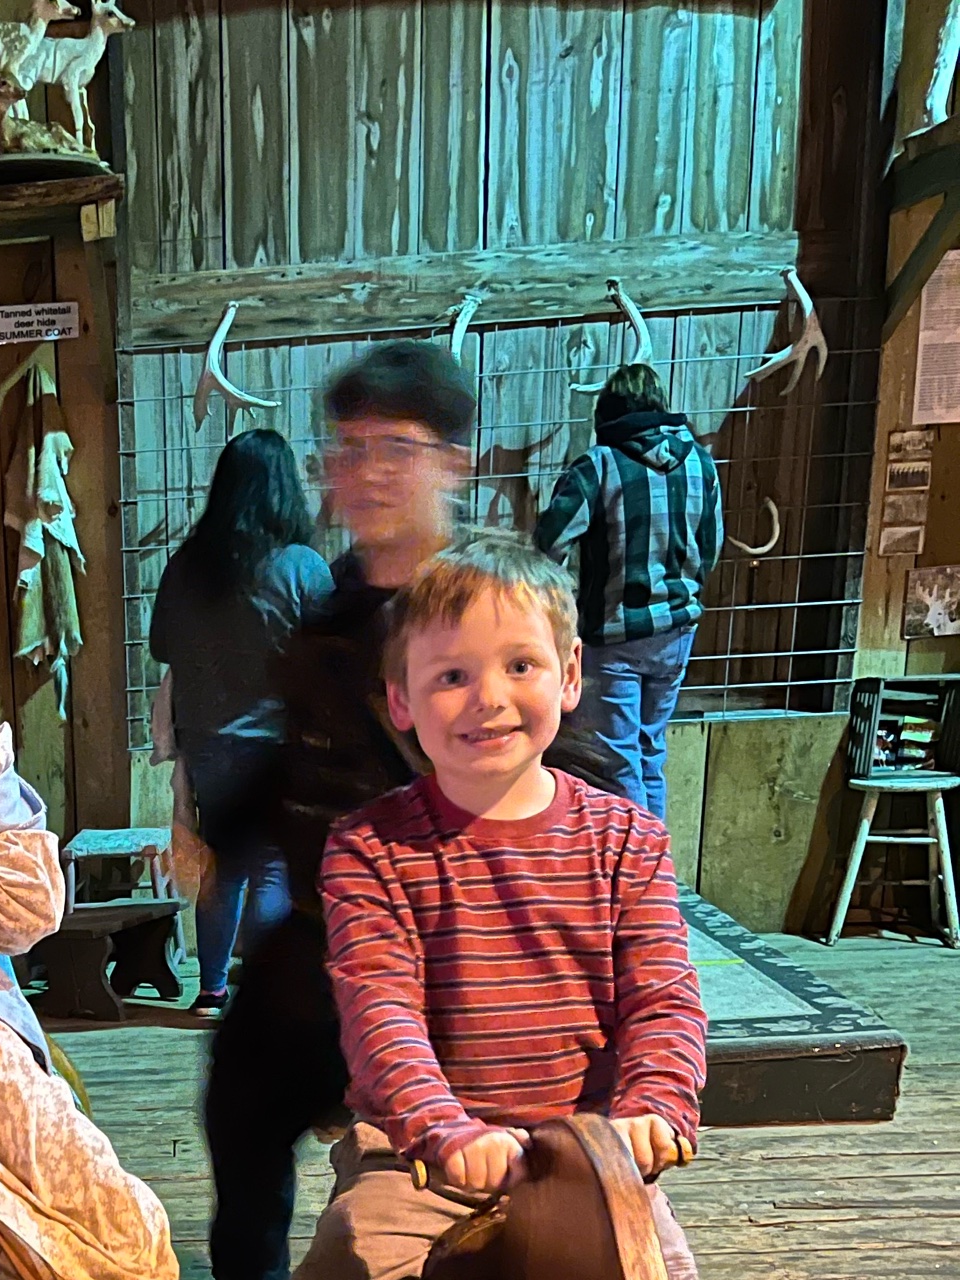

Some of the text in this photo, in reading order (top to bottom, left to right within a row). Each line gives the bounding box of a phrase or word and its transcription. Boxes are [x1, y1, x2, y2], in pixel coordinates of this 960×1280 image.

[0, 306, 71, 318] Tanned whitetail
[14, 318, 56, 328] deer hide
[0, 327, 72, 340] SUMMER COAT
